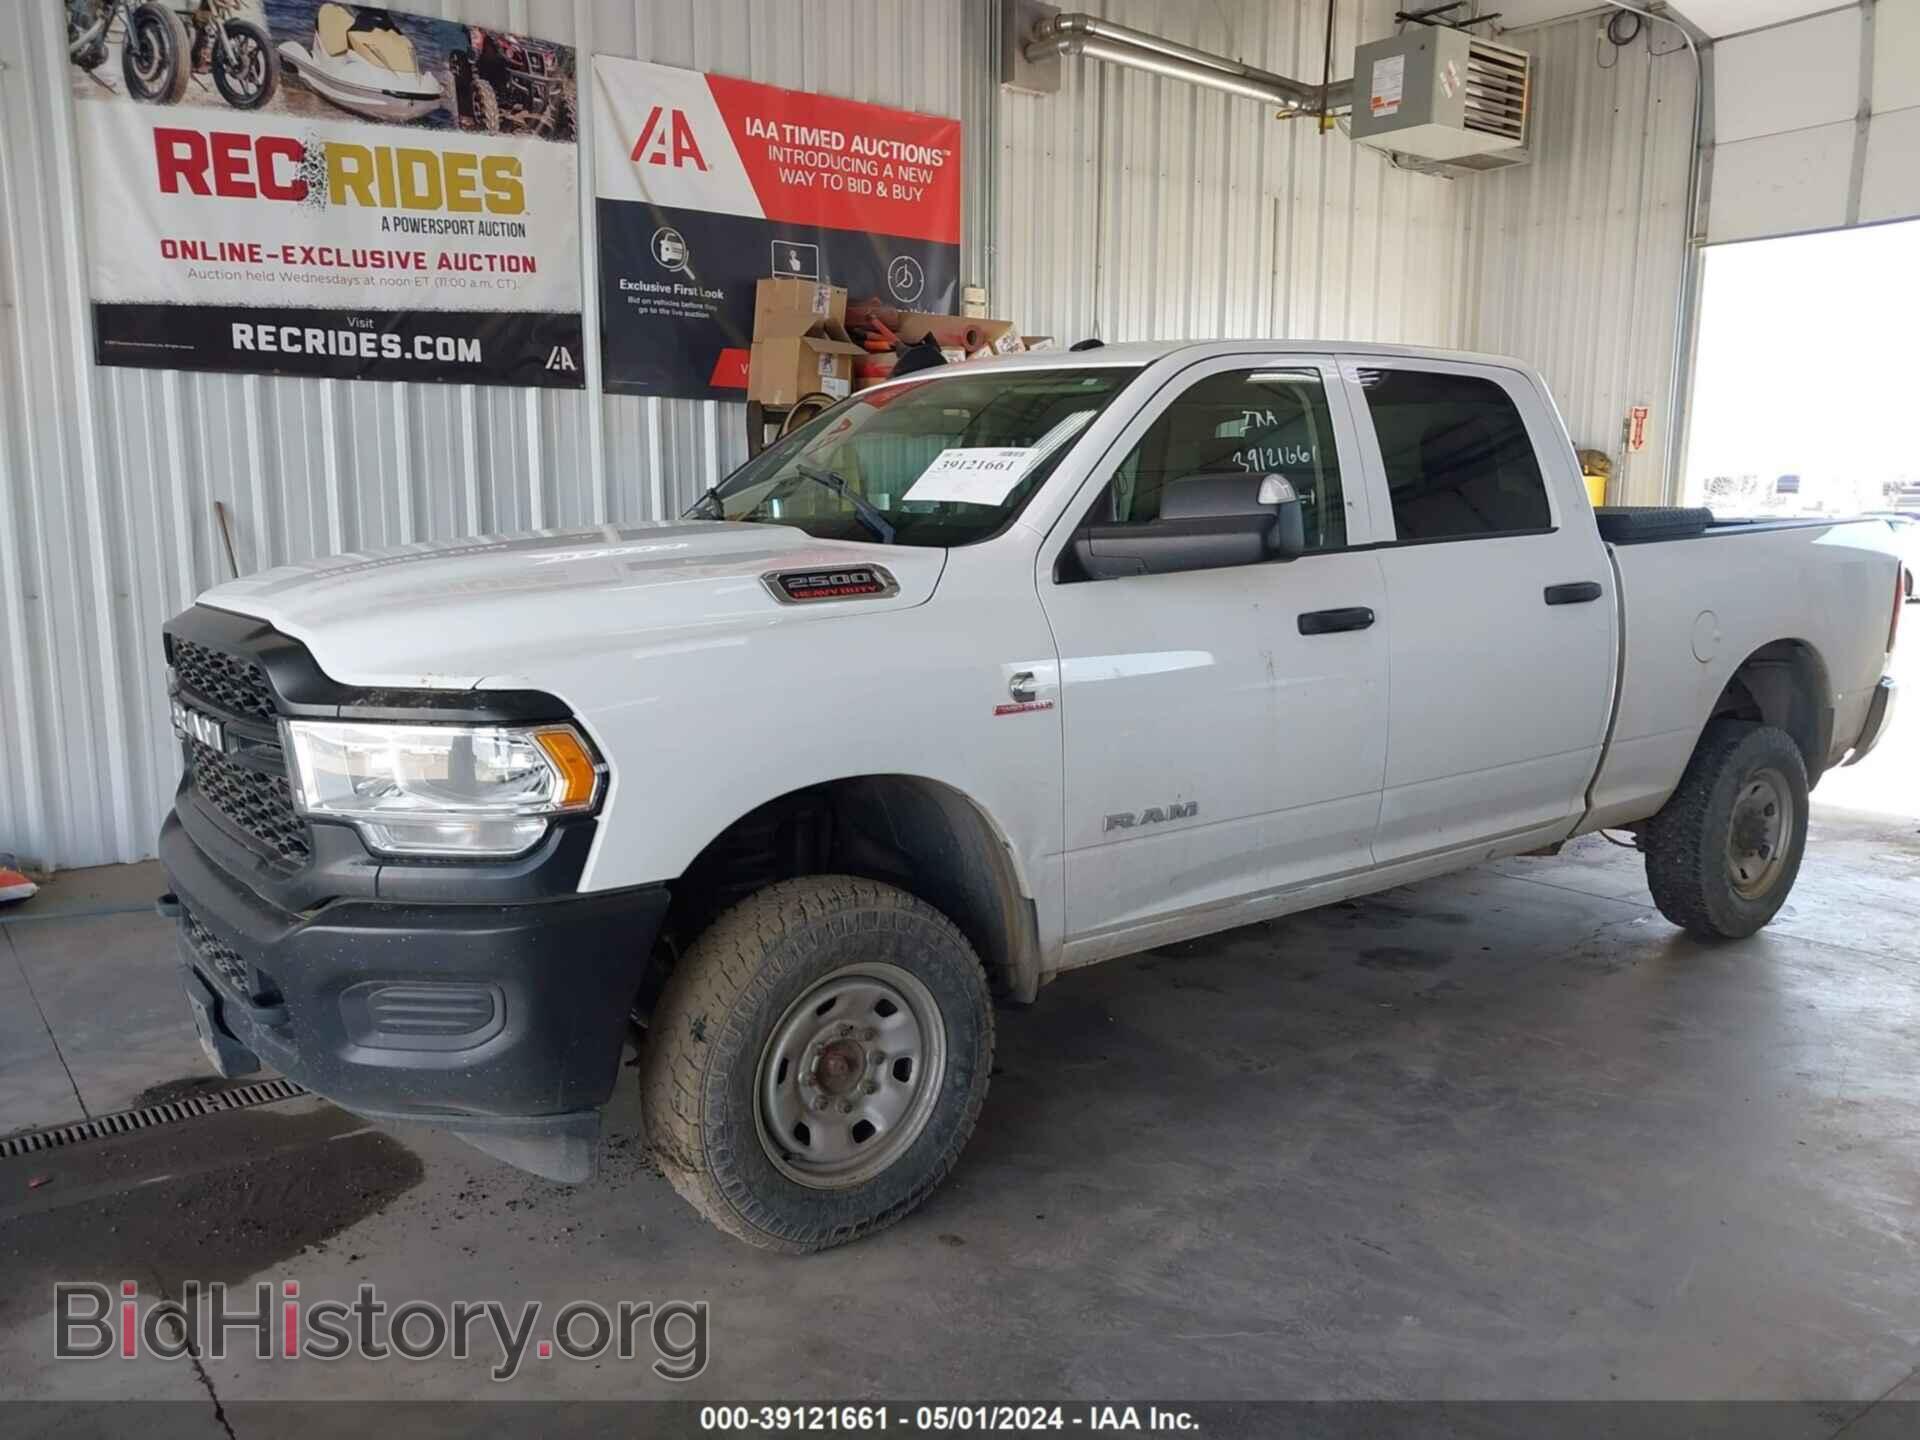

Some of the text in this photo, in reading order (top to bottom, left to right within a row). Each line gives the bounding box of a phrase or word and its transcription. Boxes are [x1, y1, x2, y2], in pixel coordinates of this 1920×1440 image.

[745, 116, 778, 142] IAA
[781, 123, 846, 151] TIMED
[153, 127, 526, 215] REC RIDES
[768, 145, 933, 184] INTRODUCING A NEW
[779, 167, 924, 202] WAY TO BID & BUY
[381, 216, 527, 238] A POWERSPORT AUCTION
[160, 239, 537, 273] ONLINE-EXCLUSIVE AUCTION
[187, 267, 242, 281] Auction
[244, 270, 275, 282] held
[279, 272, 360, 287] Wednesdays
[364, 276, 375, 286] at
[379, 278, 411, 287] noon
[415, 278, 429, 287] ET
[470, 280, 493, 289] a.m.
[619, 278, 725, 300] Exclusive First Look
[347, 317, 375, 329] Visit
[232, 322, 483, 363] RECRIDES.COM
[1232, 444, 1317, 473] 39121661
[786, 573, 872, 588] 2500
[1103, 800, 1199, 832] RAM
